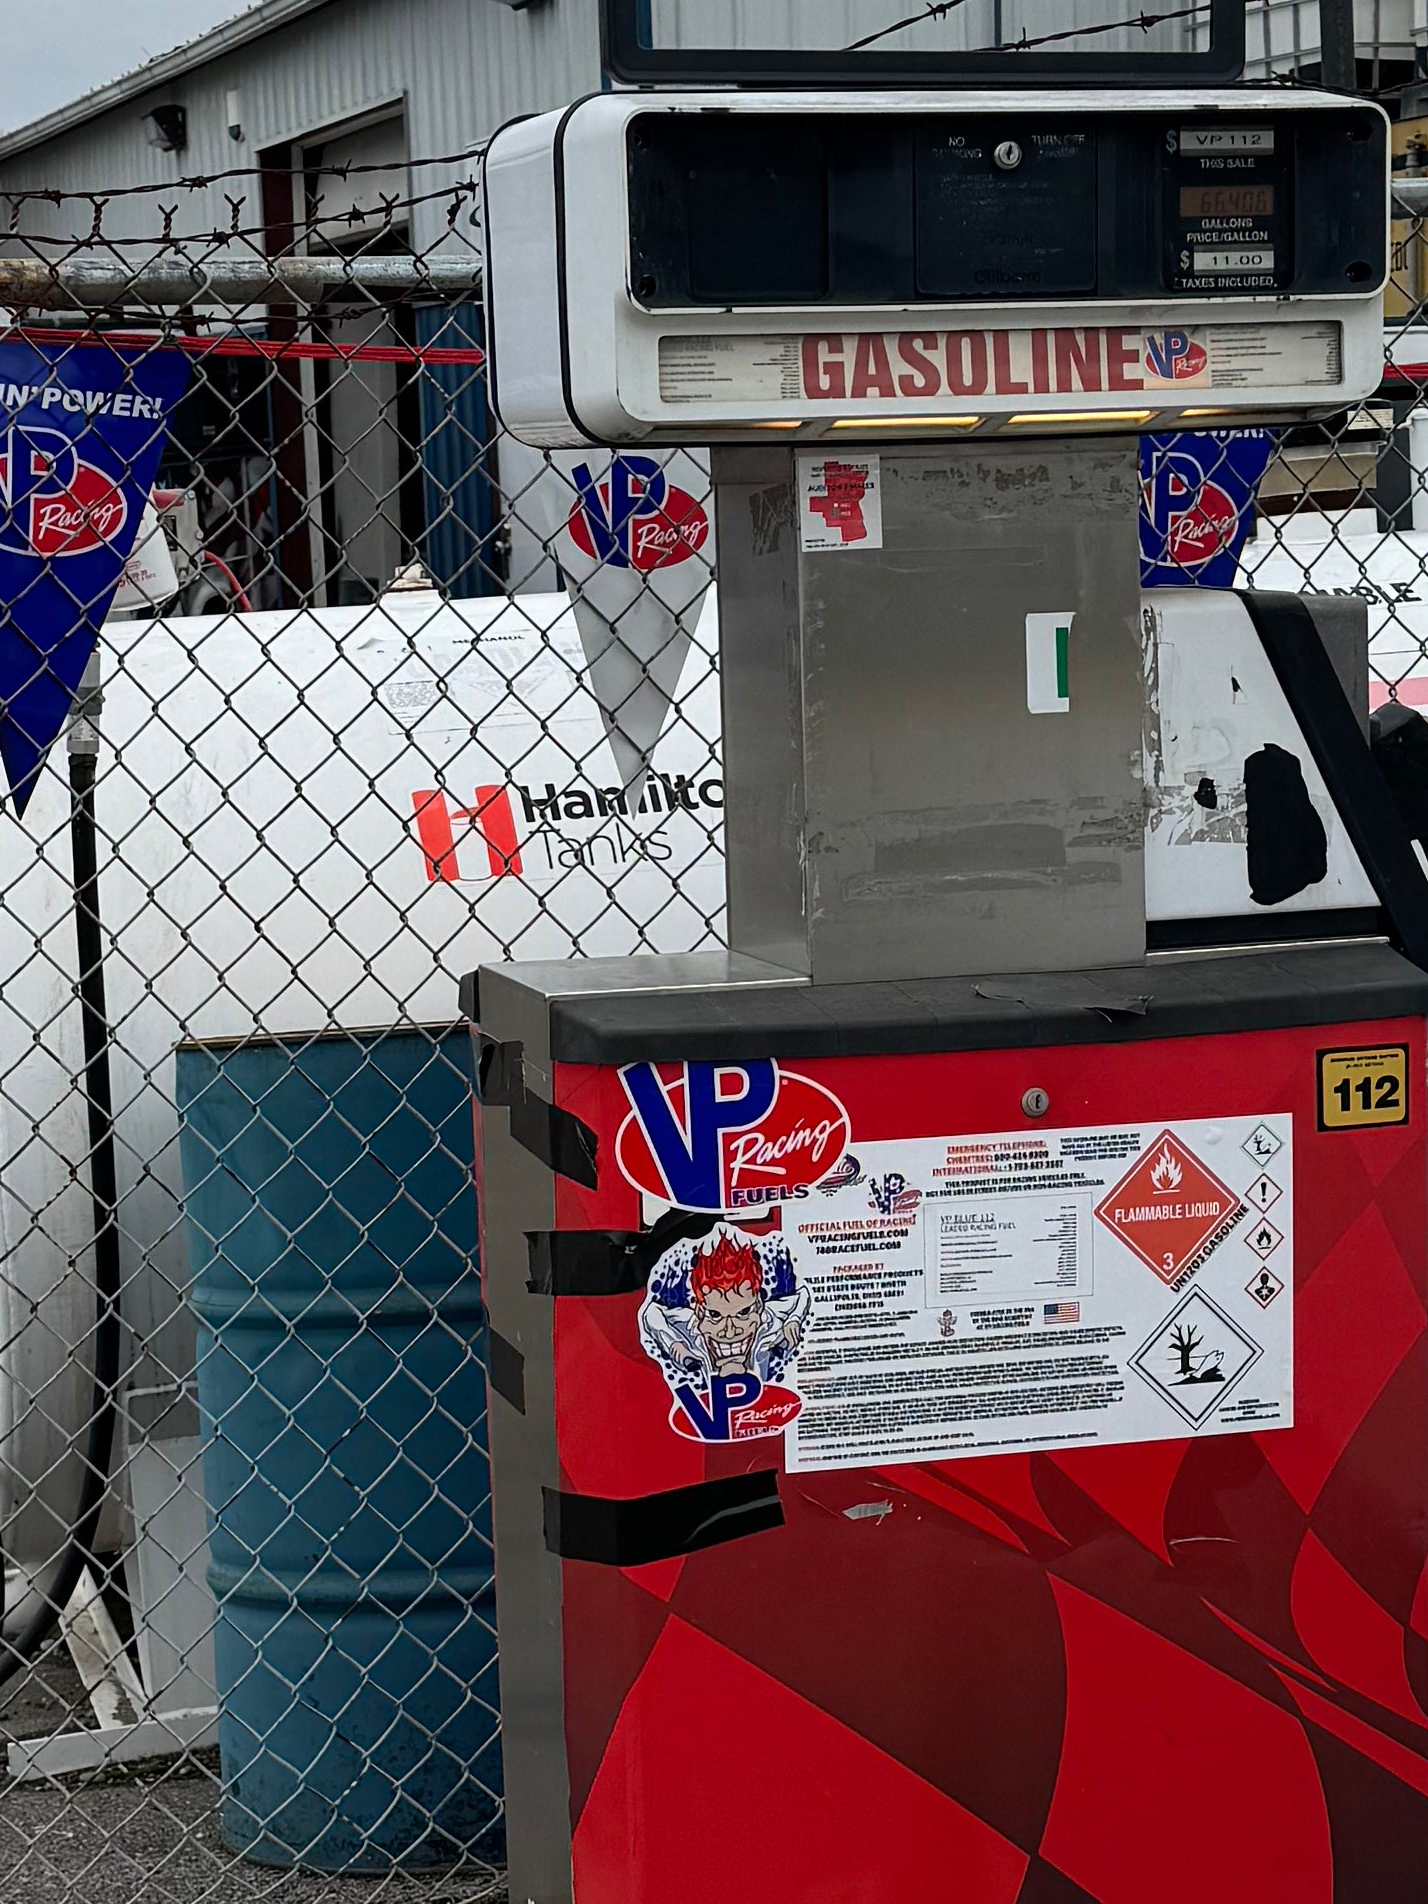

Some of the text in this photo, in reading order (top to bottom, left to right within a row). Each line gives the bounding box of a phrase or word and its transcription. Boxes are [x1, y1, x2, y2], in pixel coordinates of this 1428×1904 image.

[1196, 134, 1223, 145] VP
[1230, 134, 1262, 145] 112
[1186, 231, 1269, 243] PRICE/GALLON
[1201, 218, 1253, 229] GALLONS
[1180, 249, 1263, 271] $ 11.00
[1182, 278, 1215, 288] TAXES
[801, 327, 1144, 400] GASOLINE
[1146, 330, 1190, 379] VP
[41, 387, 163, 420] POWER!
[570, 455, 668, 569] VP
[637, 520, 708, 559] Racng
[528, 822, 673, 871] Tanks
[1333, 1074, 1401, 1112] 112
[619, 1058, 780, 1210] VP
[729, 1117, 846, 1188] Racing
[730, 1183, 810, 1207] FUELS
[1114, 1201, 1220, 1224] FLAMMABLE LIQUID
[1162, 1251, 1175, 1271] 3
[674, 1372, 764, 1441] VP
[733, 1400, 802, 1429] Racing
